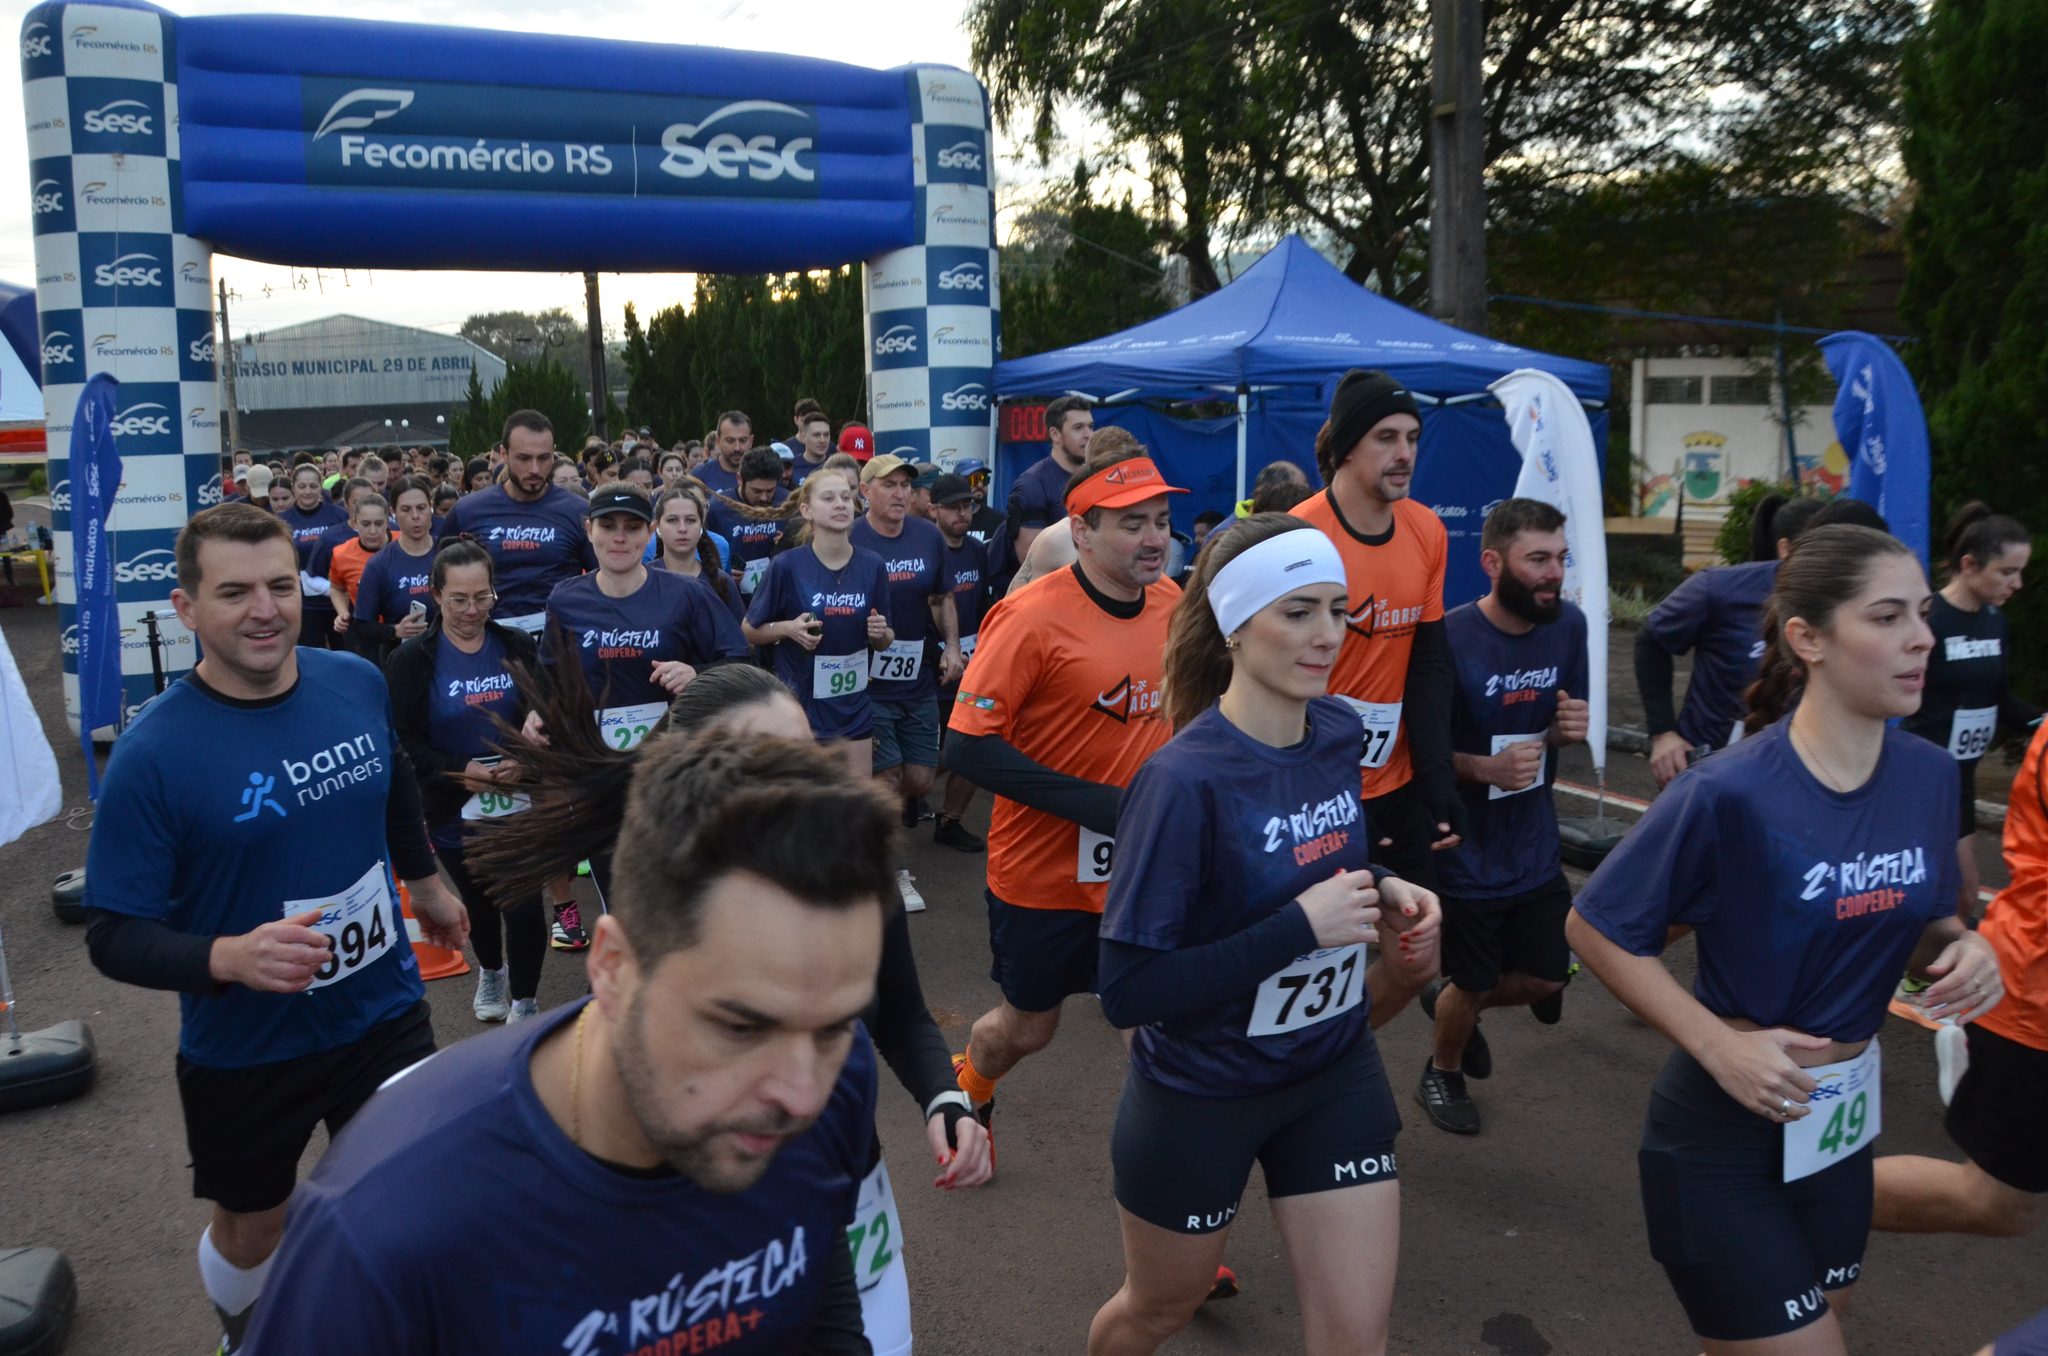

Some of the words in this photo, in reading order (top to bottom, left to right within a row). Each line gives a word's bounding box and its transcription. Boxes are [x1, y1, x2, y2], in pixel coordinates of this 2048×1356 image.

[340, 135, 554, 173] Fecomércio
[565, 144, 613, 175] RS
[87, 194, 149, 206] Fecomércio
[97, 347, 158, 356] Fecomércio
[292, 358, 378, 376] MUNICIPAL
[383, 357, 403, 372] 29
[407, 356, 427, 371] DE
[432, 356, 471, 370] ABRIL
[83, 517, 99, 590] Sindicatos
[598, 647, 643, 659] COOPERA+
[601, 628, 659, 648] RÚSTICA
[466, 673, 513, 693] RÚSTICA
[830, 670, 857, 694] 99
[879, 655, 915, 678] 738
[1504, 666, 1558, 690] RÚSTICA
[282, 733, 376, 786] banri
[296, 756, 383, 807] runners
[1289, 790, 1359, 844] RÚSTICA
[1292, 830, 1349, 866] COOPERA+
[1840, 847, 1926, 895] RÚSTICA
[1835, 887, 1907, 920] COOPERA+
[1817, 1090, 1866, 1155] 49
[1187, 1201, 1238, 1229] RUN
[629, 1225, 808, 1350] RÚSTICA
[1784, 1284, 1826, 1322] RUN
